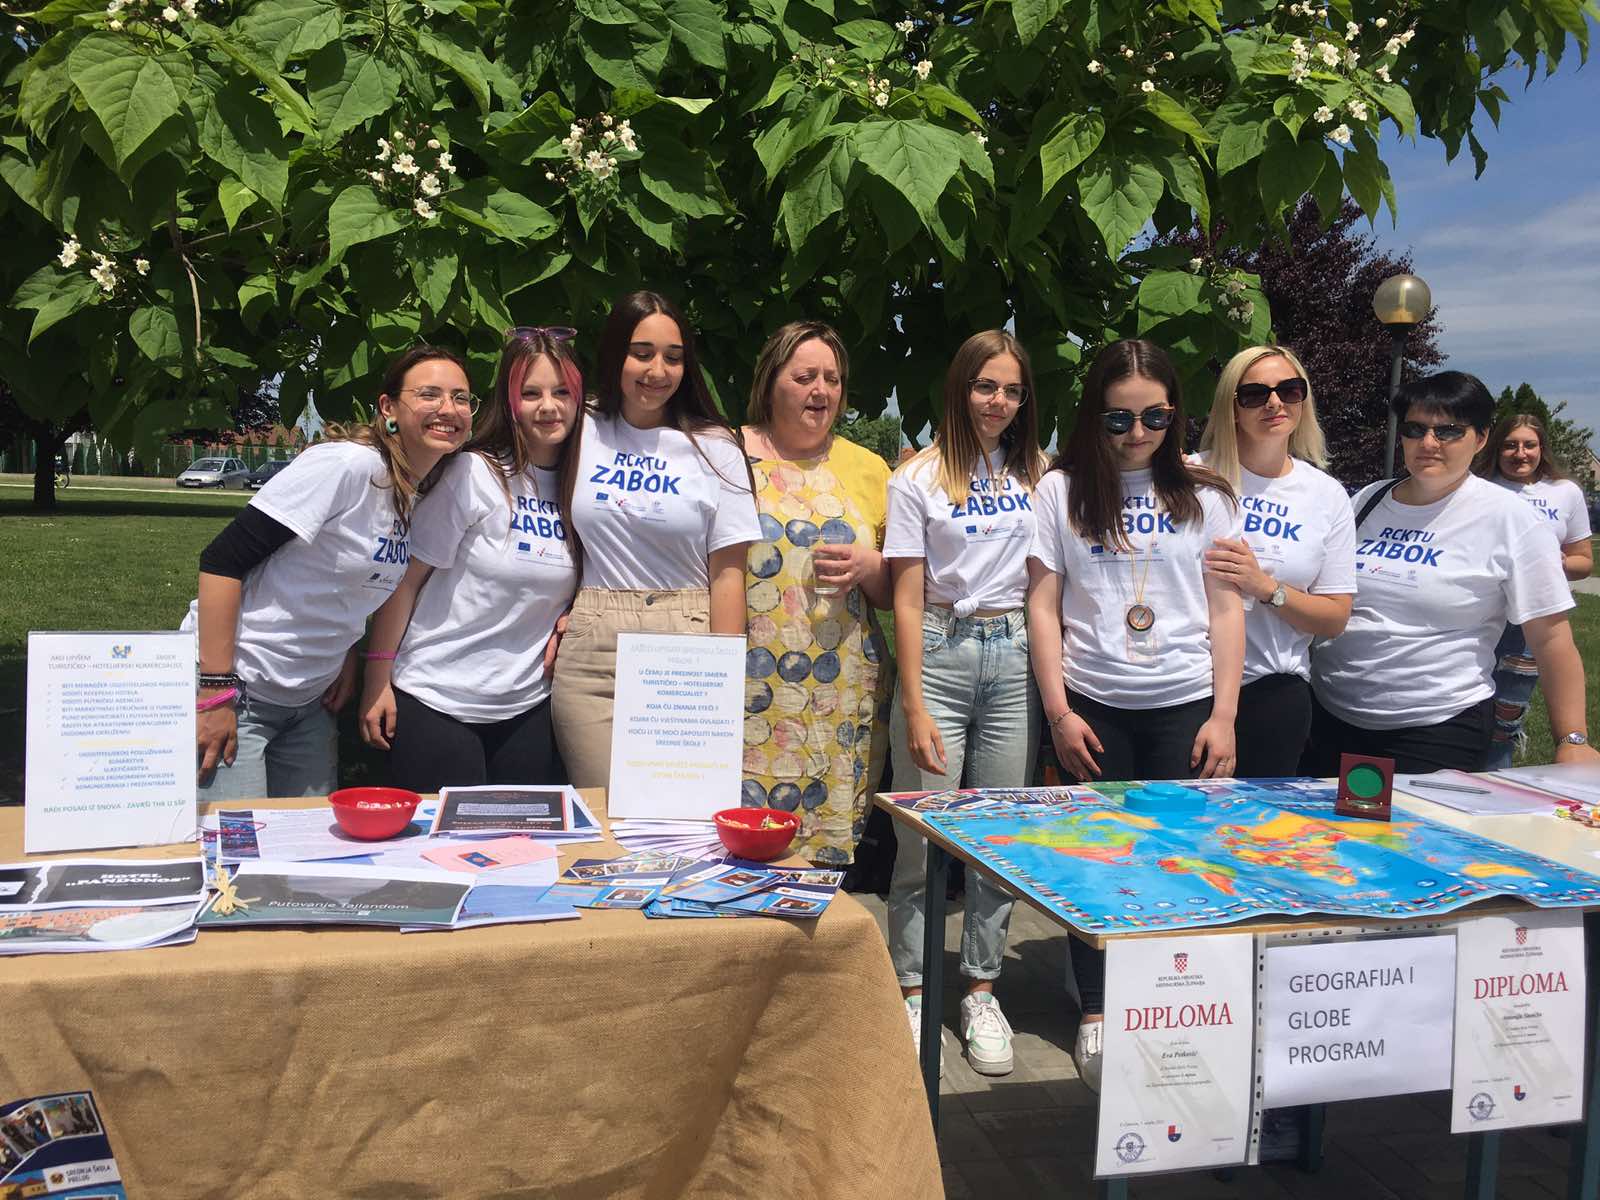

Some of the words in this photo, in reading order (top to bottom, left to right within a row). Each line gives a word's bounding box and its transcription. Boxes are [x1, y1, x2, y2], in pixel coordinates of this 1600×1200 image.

[614, 452, 666, 471] RCKTU
[590, 464, 682, 495] ZABOK
[970, 479, 1011, 492] CKU
[1122, 496, 1156, 510] KTU
[1240, 496, 1288, 517] CKTU
[510, 510, 568, 540] ZABO
[1122, 513, 1176, 534] BOK
[1244, 512, 1303, 542] BOK
[1380, 527, 1435, 542] RCKTU
[1356, 539, 1444, 567] ZABOK
[268, 900, 336, 909] Putovanje
[340, 902, 409, 910] Tajlandom
[1289, 967, 1404, 993] GEOGRAFIJA
[1409, 966, 1414, 984] I
[1474, 970, 1568, 1000] DIPLOMA
[1124, 1002, 1233, 1031] DIPLOMA
[1288, 1008, 1351, 1030] GLOBE
[1289, 1038, 1385, 1064] PROGRAM
